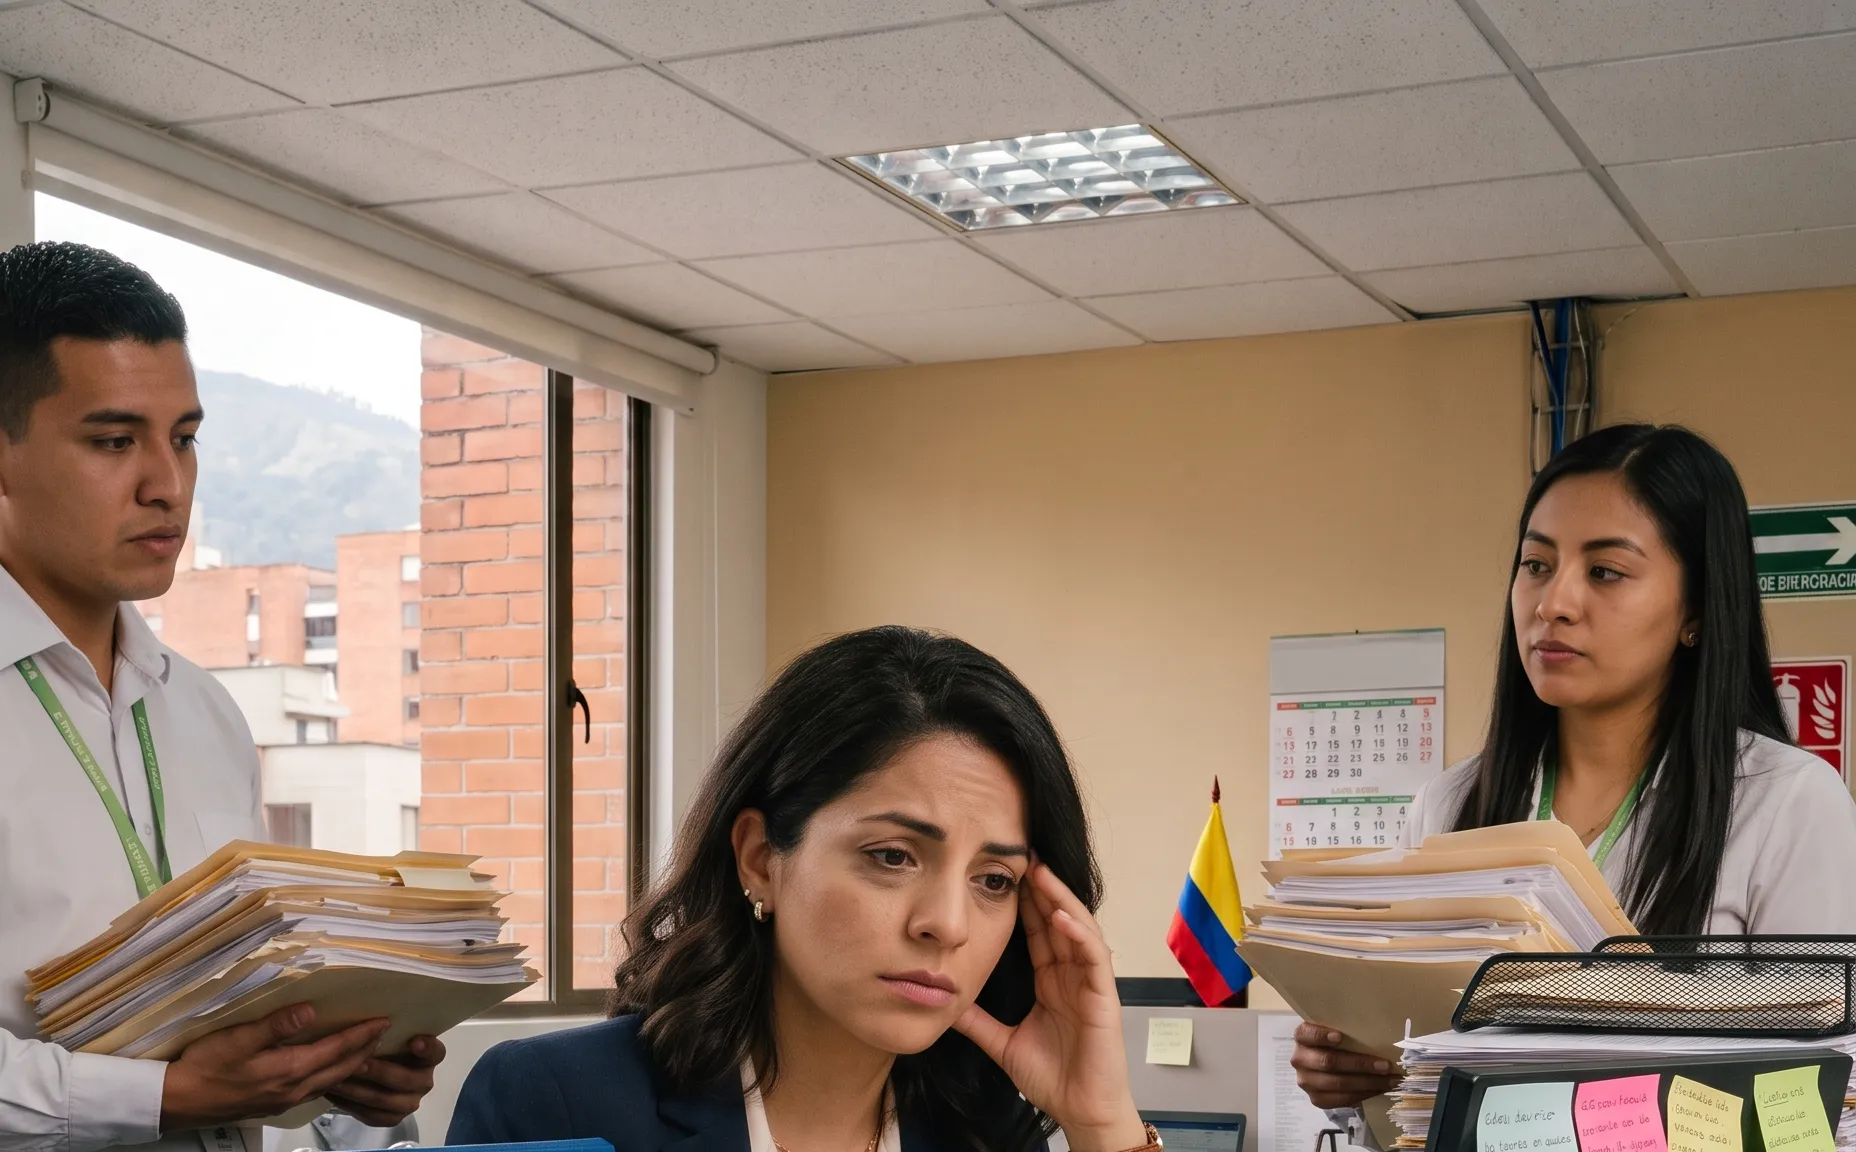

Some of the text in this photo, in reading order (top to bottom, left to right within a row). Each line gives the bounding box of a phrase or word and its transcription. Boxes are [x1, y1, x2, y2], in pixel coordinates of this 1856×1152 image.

[1374, 724, 1384, 733] 11
[1397, 723, 1408, 733] 12
[1421, 723, 1432, 732] 13
[1328, 740, 1339, 749] 15
[1351, 739, 1362, 749] 17
[1420, 737, 1432, 747] 20
[1283, 756, 1294, 765] 21
[1328, 755, 1339, 763] 22
[1350, 754, 1362, 762] 23
[1373, 753, 1385, 762] 25
[1396, 752, 1408, 761] 26
[1420, 751, 1432, 761] 27
[1305, 769, 1317, 779] 28
[1327, 769, 1339, 778] 29
[1350, 768, 1362, 777] 30
[1374, 821, 1385, 830] 10
[1327, 836, 1339, 845] 15
[1350, 836, 1362, 844] 16
[1373, 835, 1385, 844] 15
